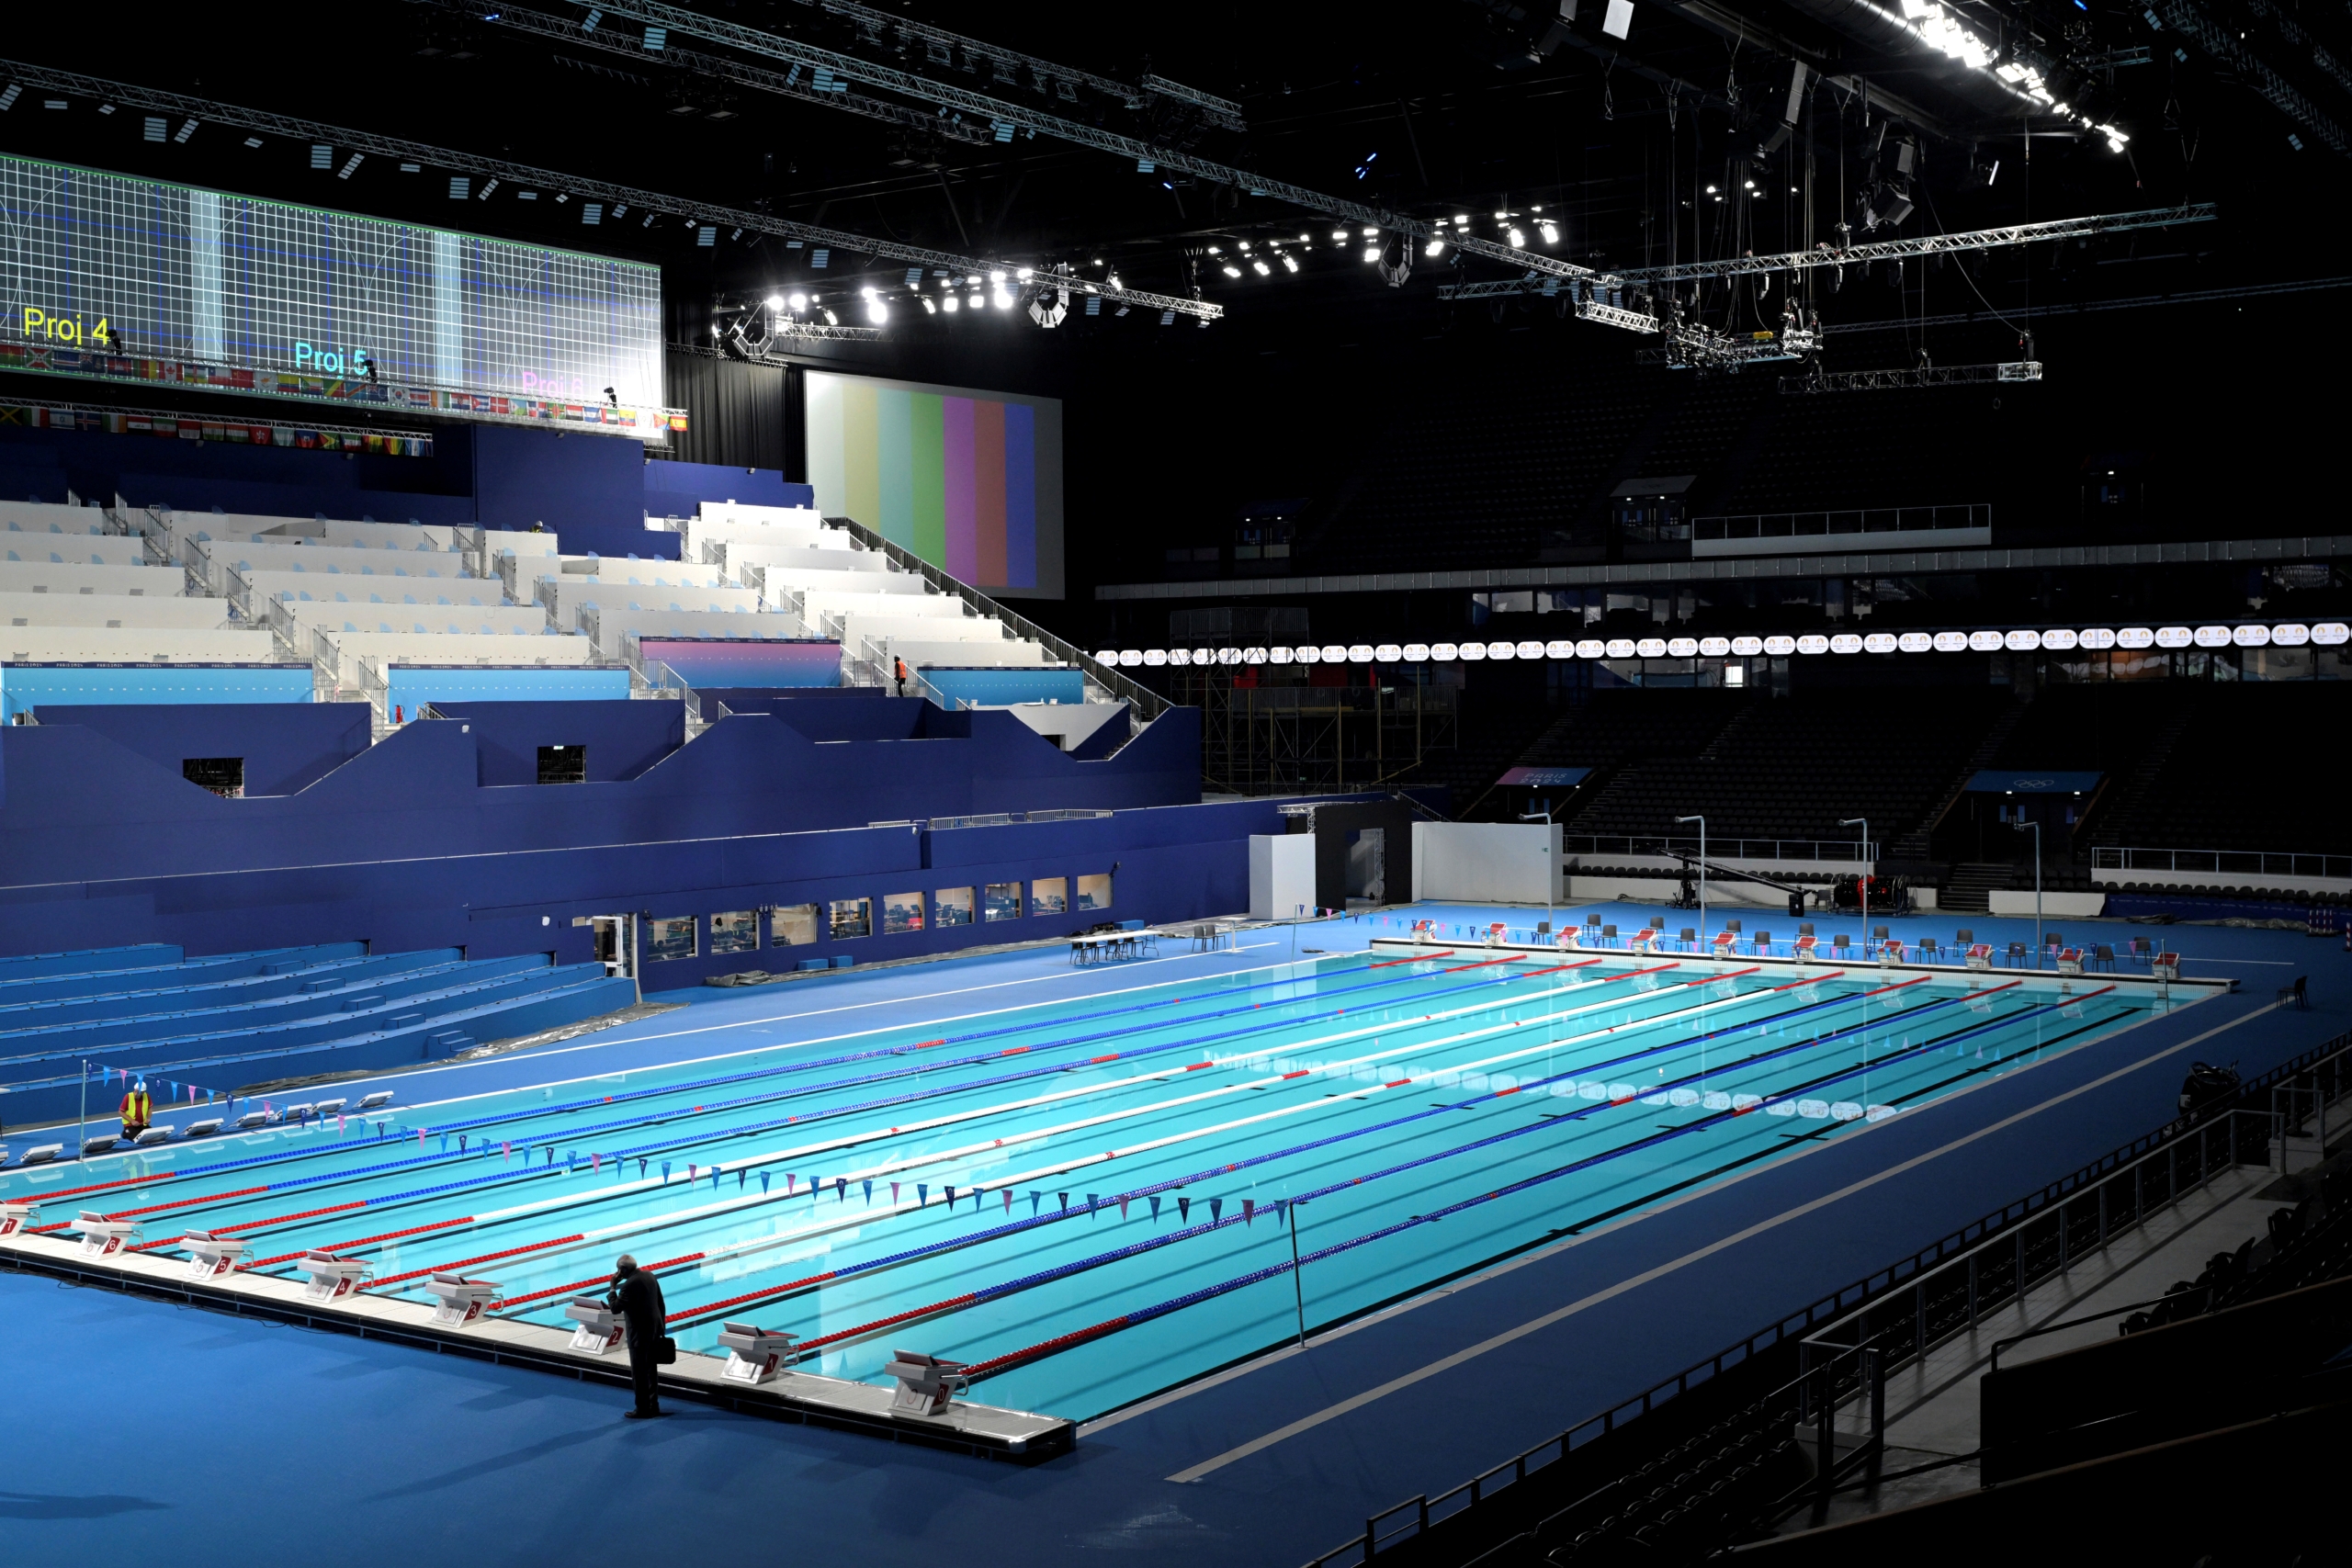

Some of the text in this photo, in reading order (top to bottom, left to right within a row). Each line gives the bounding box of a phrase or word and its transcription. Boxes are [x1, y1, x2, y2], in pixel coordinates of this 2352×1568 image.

[25, 308, 109, 350] Proj 4
[296, 342, 368, 378] Proj 5
[7, 1221, 13, 1231] 7
[109, 1240, 115, 1250] 6
[220, 1260, 227, 1271] 5
[339, 1282, 345, 1292] 4
[470, 1305, 477, 1316] 3
[612, 1330, 619, 1343] 2
[769, 1358, 773, 1370] 1
[939, 1388, 944, 1401] 0
